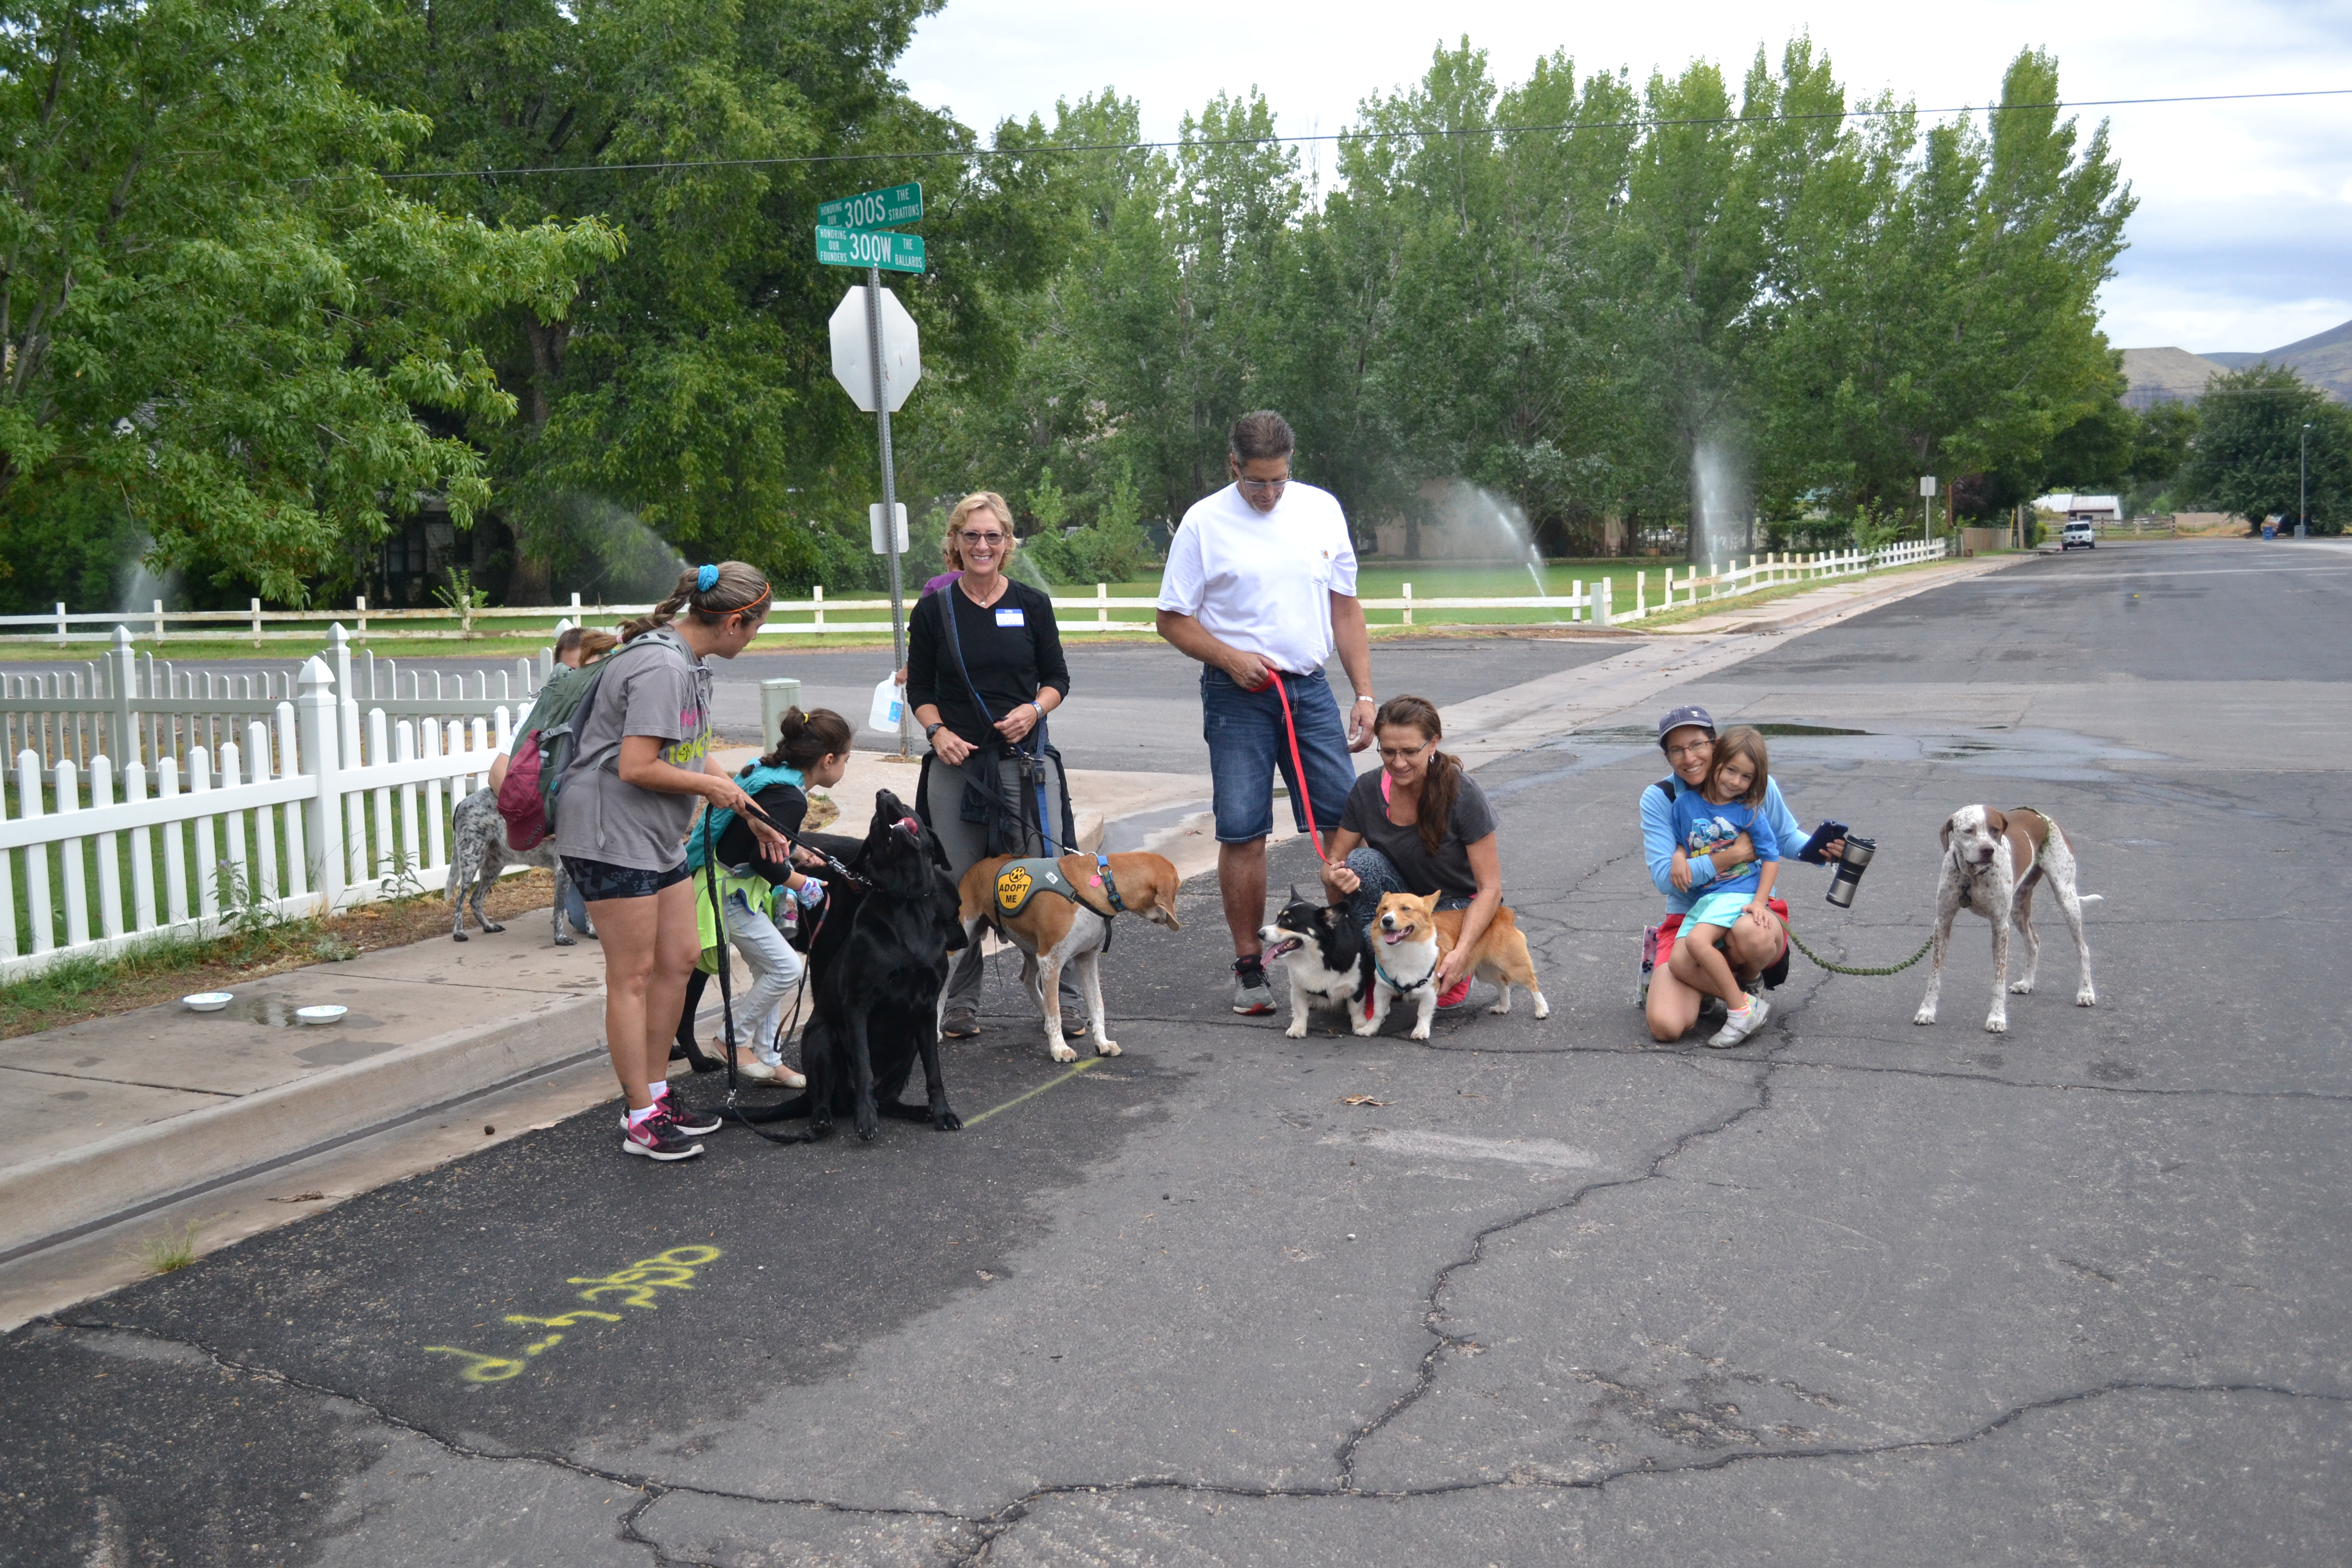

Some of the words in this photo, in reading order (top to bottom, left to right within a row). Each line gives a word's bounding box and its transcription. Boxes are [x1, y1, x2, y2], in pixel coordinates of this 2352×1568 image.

[896, 188, 910, 201] THE
[845, 195, 885, 228] 300S
[889, 204, 919, 221] STRATTONS
[820, 229, 847, 240] HONORING
[828, 240, 840, 251] OUR
[849, 233, 891, 262] 300W
[903, 238, 913, 250] THE
[820, 251, 847, 262] FOUNDERS
[895, 254, 922, 268] BALLARDS
[999, 884, 1028, 892] ADOPT
[1006, 895, 1017, 903] ME
